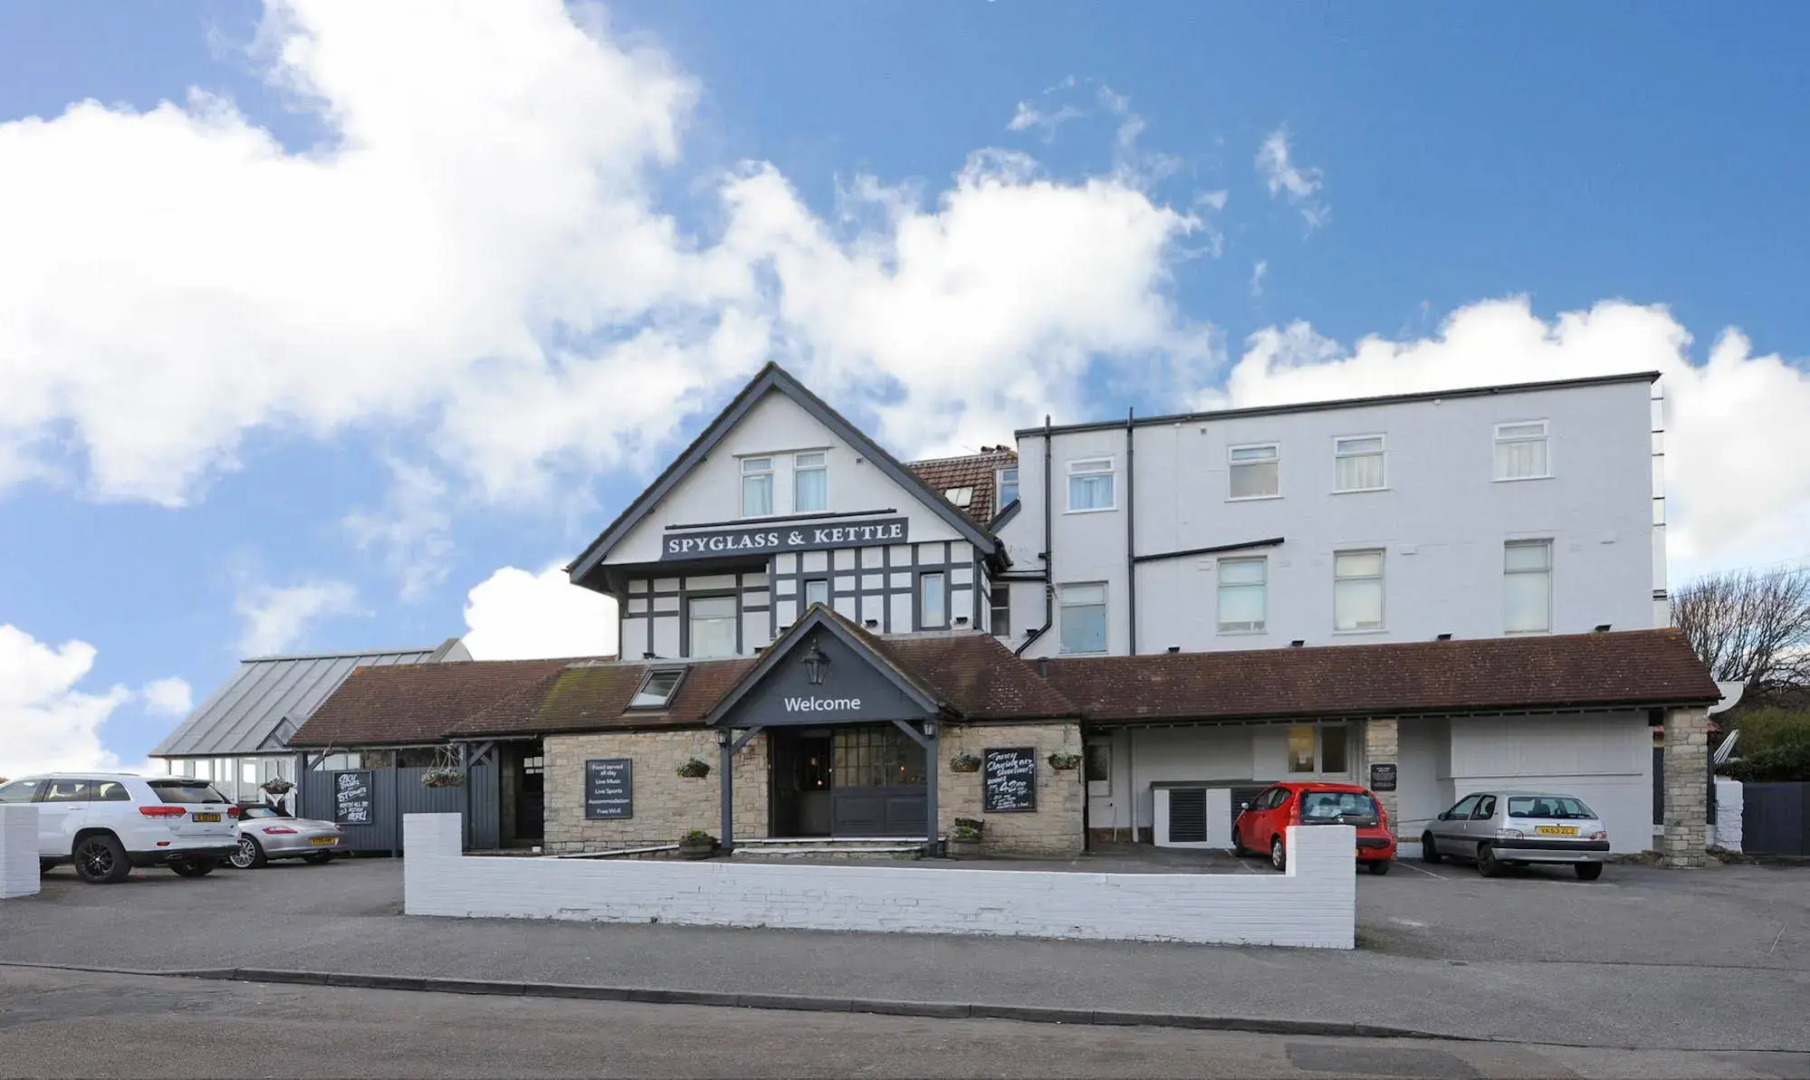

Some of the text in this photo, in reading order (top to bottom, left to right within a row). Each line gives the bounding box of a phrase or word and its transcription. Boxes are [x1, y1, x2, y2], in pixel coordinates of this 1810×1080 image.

[669, 524, 903, 553] SPYGLASS & KETTLE
[784, 696, 861, 712] Welcome
